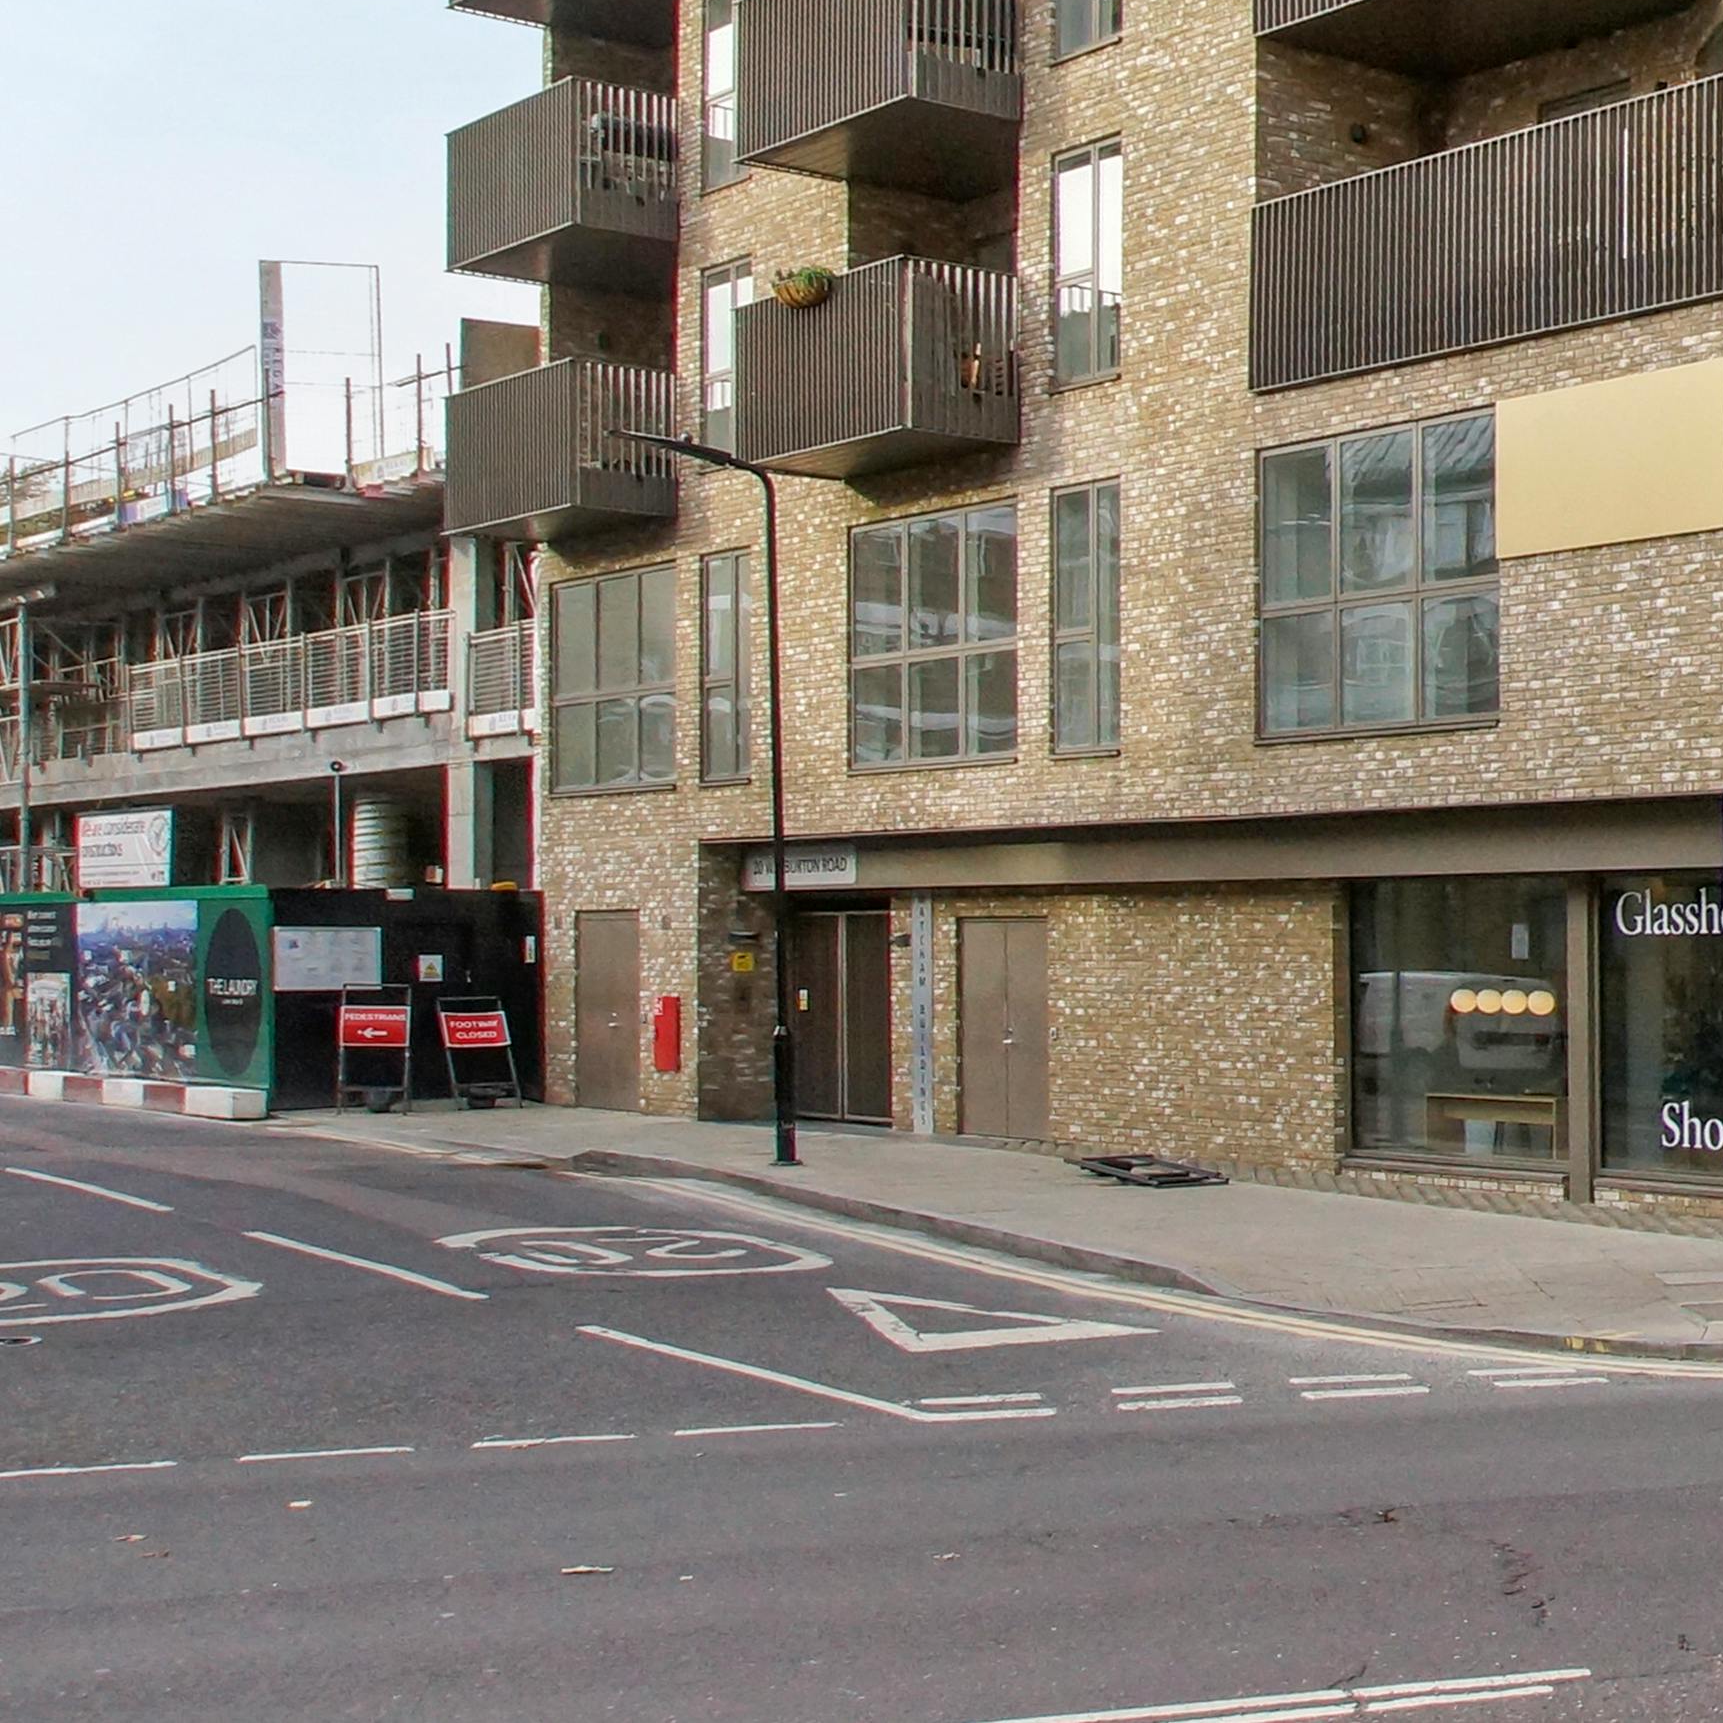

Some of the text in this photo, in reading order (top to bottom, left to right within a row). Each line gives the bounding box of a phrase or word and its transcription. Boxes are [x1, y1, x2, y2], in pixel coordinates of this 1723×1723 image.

[822, 857, 848, 872] ROAD
[345, 1013, 407, 1022] PEDESTRIANS
[450, 1020, 499, 1029] FOOTWAY
[455, 1030, 497, 1040] CLOSED
